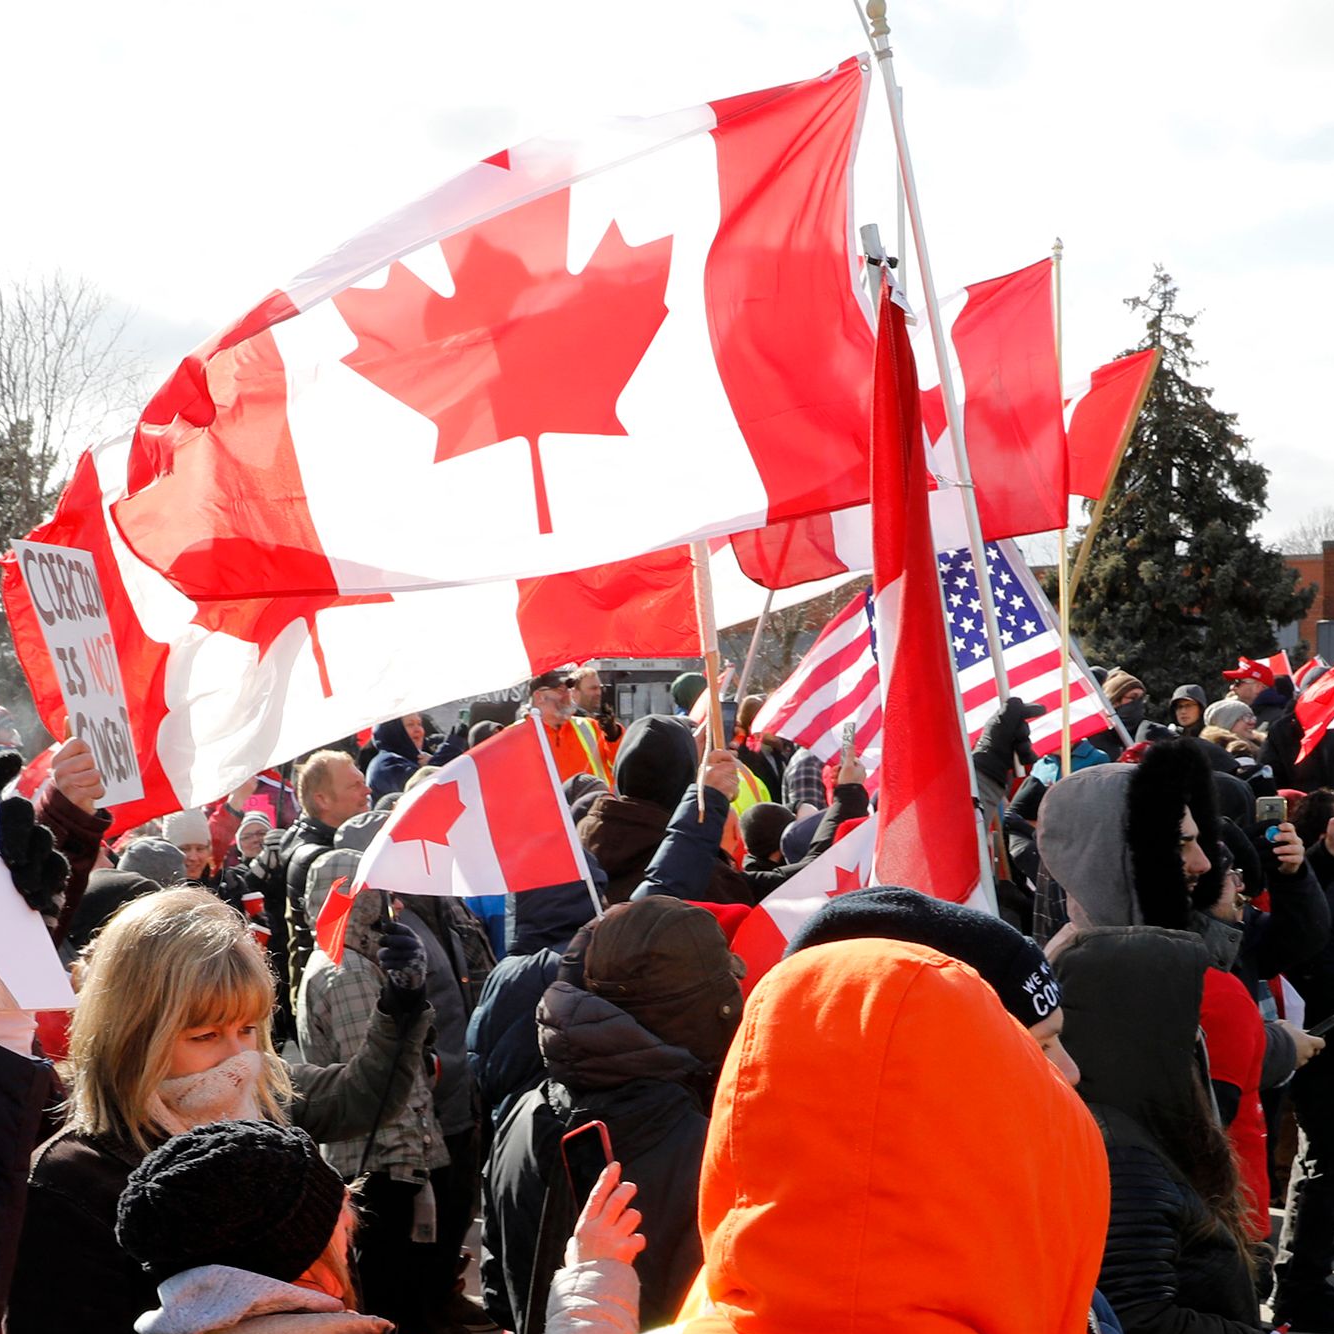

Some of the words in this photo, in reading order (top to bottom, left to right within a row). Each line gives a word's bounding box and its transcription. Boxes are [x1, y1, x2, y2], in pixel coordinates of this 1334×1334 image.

[22, 548, 108, 627] COERCION
[55, 646, 88, 699] IS
[82, 632, 117, 698] NOT
